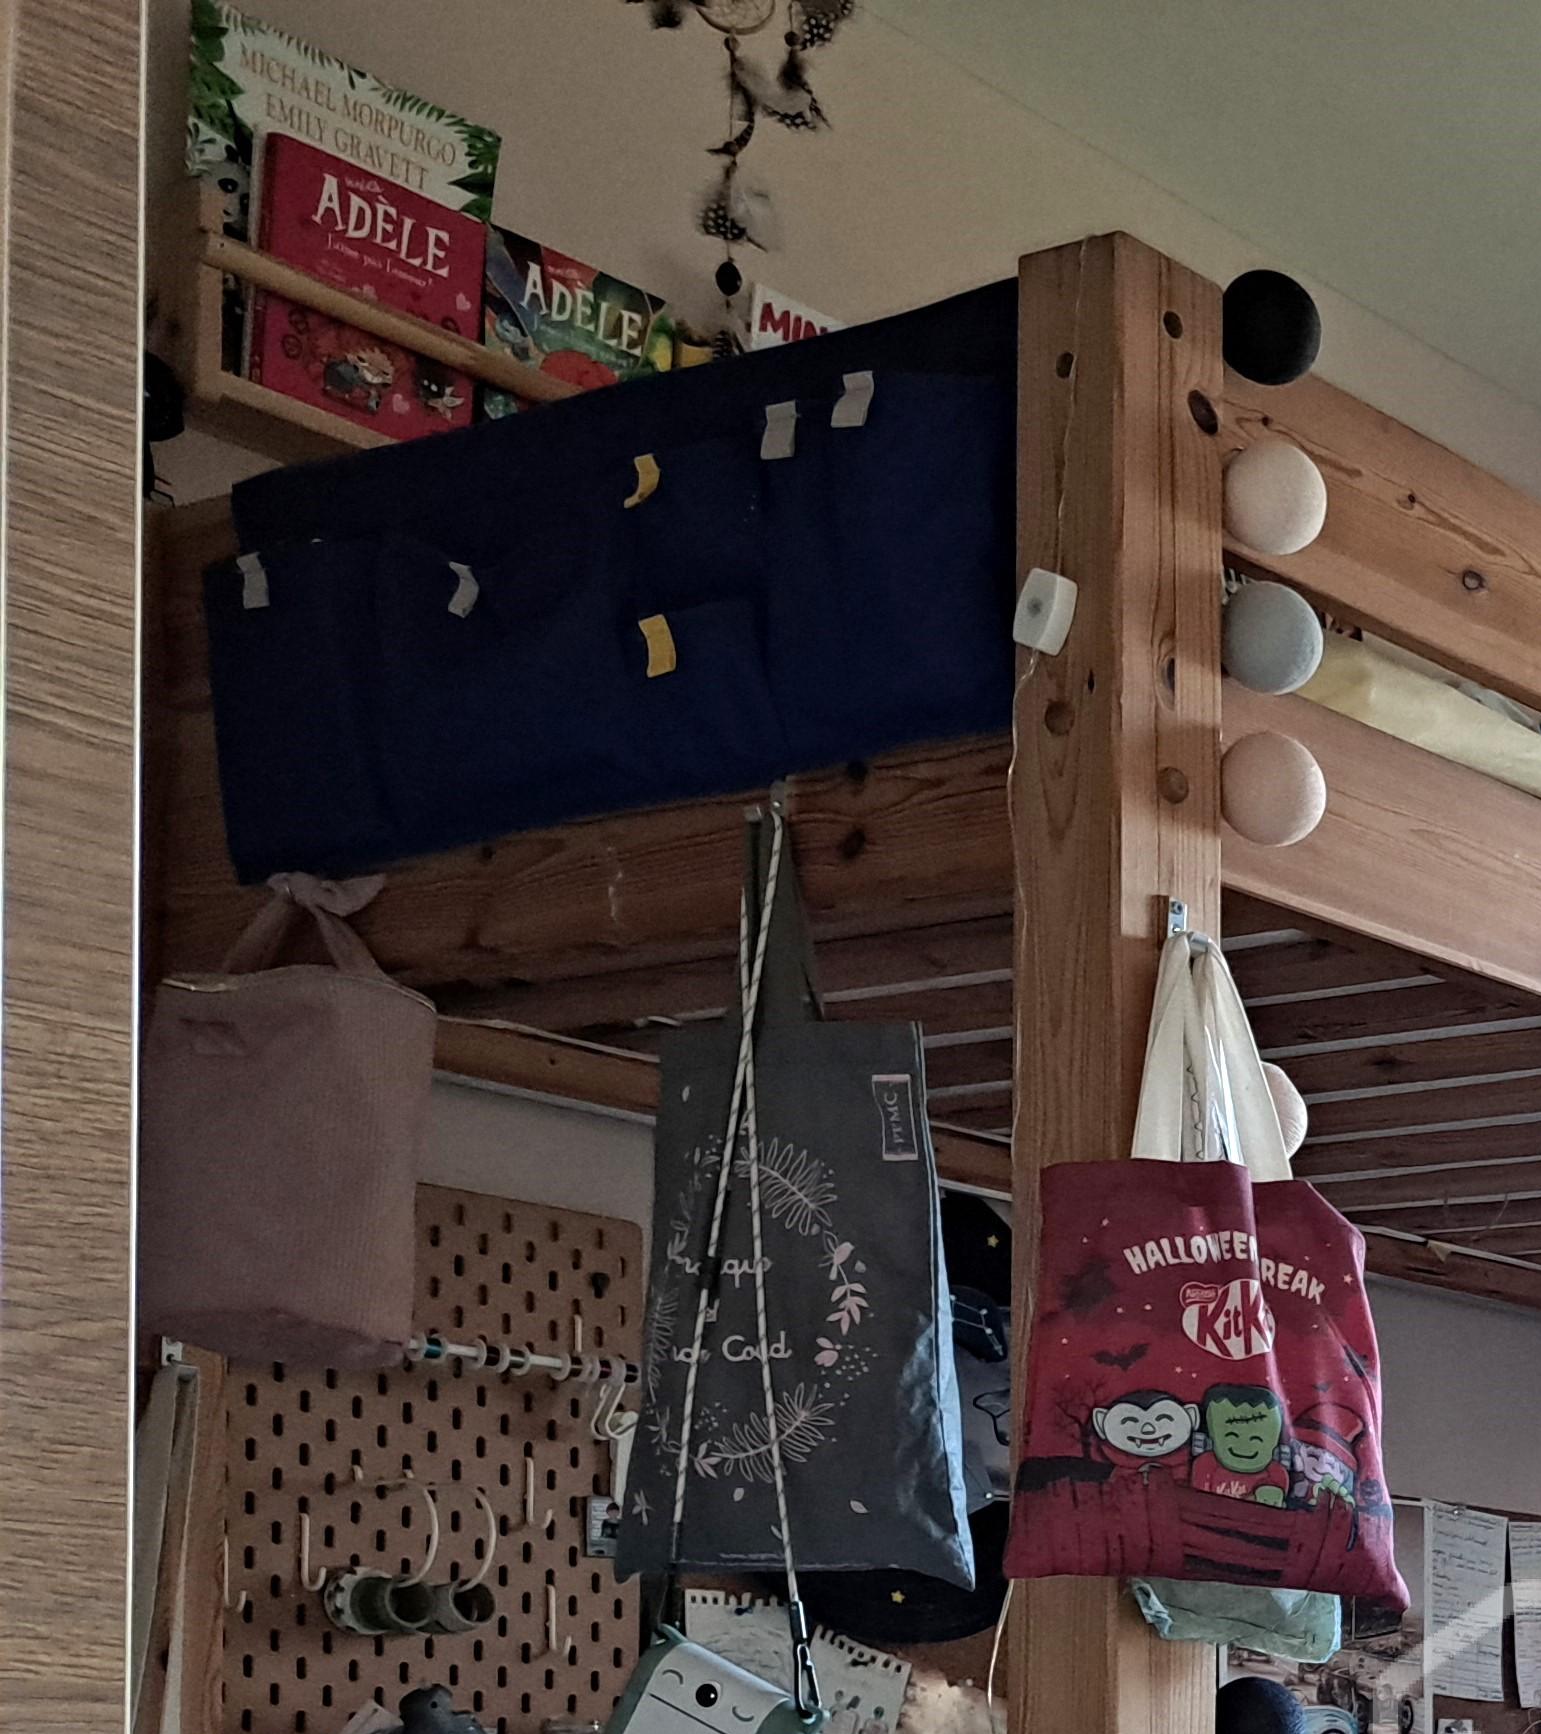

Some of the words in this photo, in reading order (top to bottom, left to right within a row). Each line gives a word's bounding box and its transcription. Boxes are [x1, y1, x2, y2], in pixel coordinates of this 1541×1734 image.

[240, 42, 337, 112] MICHAEL
[343, 94, 457, 168] MORPURGO
[265, 93, 329, 144] EMILY
[334, 128, 429, 190] GRAVETT
[312, 173, 450, 278] ADÈLE
[1260, 1257, 1326, 1305] REAK
